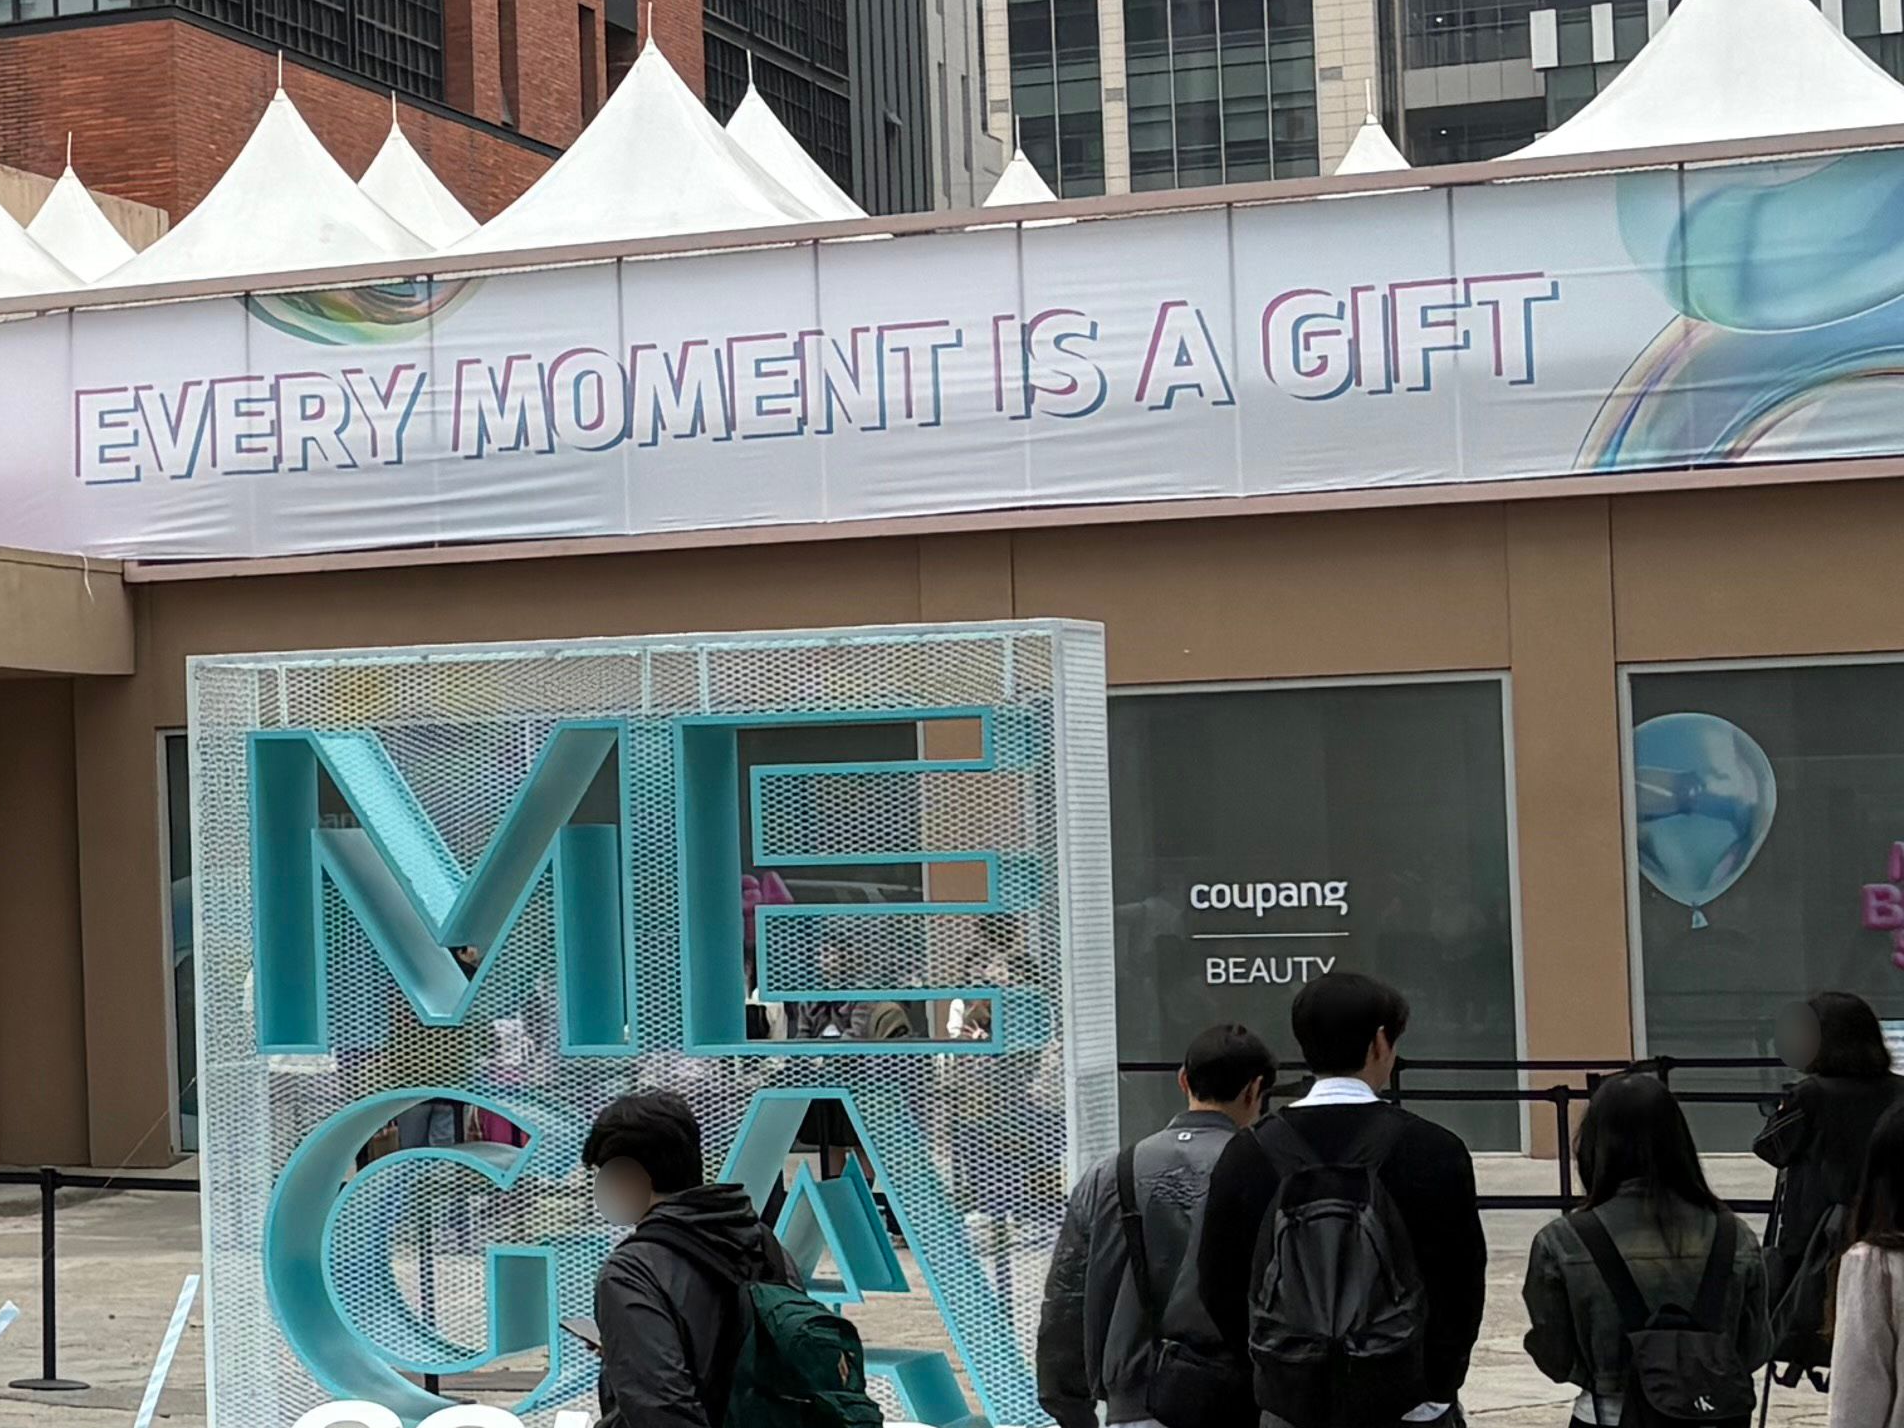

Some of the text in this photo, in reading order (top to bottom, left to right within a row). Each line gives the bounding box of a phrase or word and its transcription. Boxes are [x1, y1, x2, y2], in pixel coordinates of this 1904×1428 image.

[75, 272, 1560, 485] EVERY MOMENT IS A GIFT
[1190, 880, 1348, 917] coupang
[1206, 956, 1336, 983] BEAUTY
